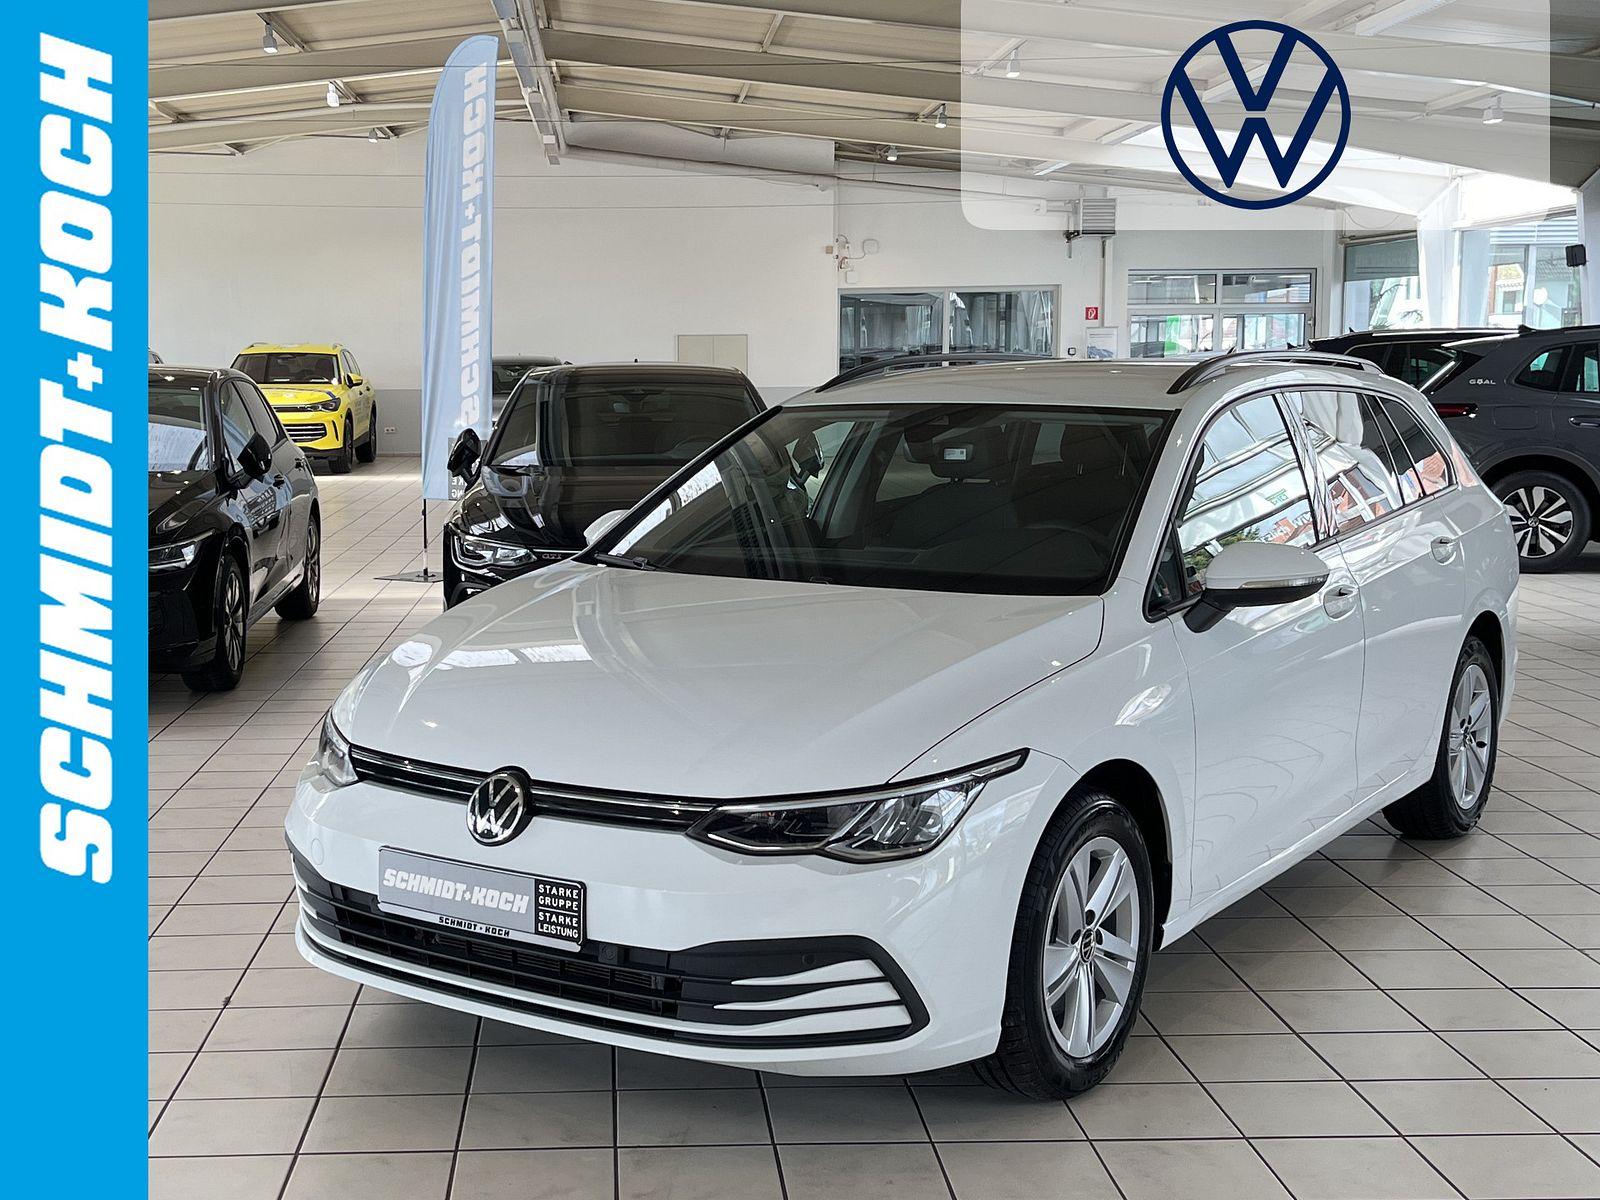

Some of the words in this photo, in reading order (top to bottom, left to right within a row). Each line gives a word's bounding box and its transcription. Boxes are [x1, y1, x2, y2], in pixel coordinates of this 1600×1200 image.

[383, 868, 530, 914] SCHMIDT+KOCH
[538, 884, 579, 899] STARKE
[538, 895, 579, 911] GRUPPE
[438, 916, 478, 931] SCHMIDT
[485, 925, 511, 937] KOCH
[538, 911, 579, 927] STARKE
[538, 922, 579, 938] LEISTUNG
